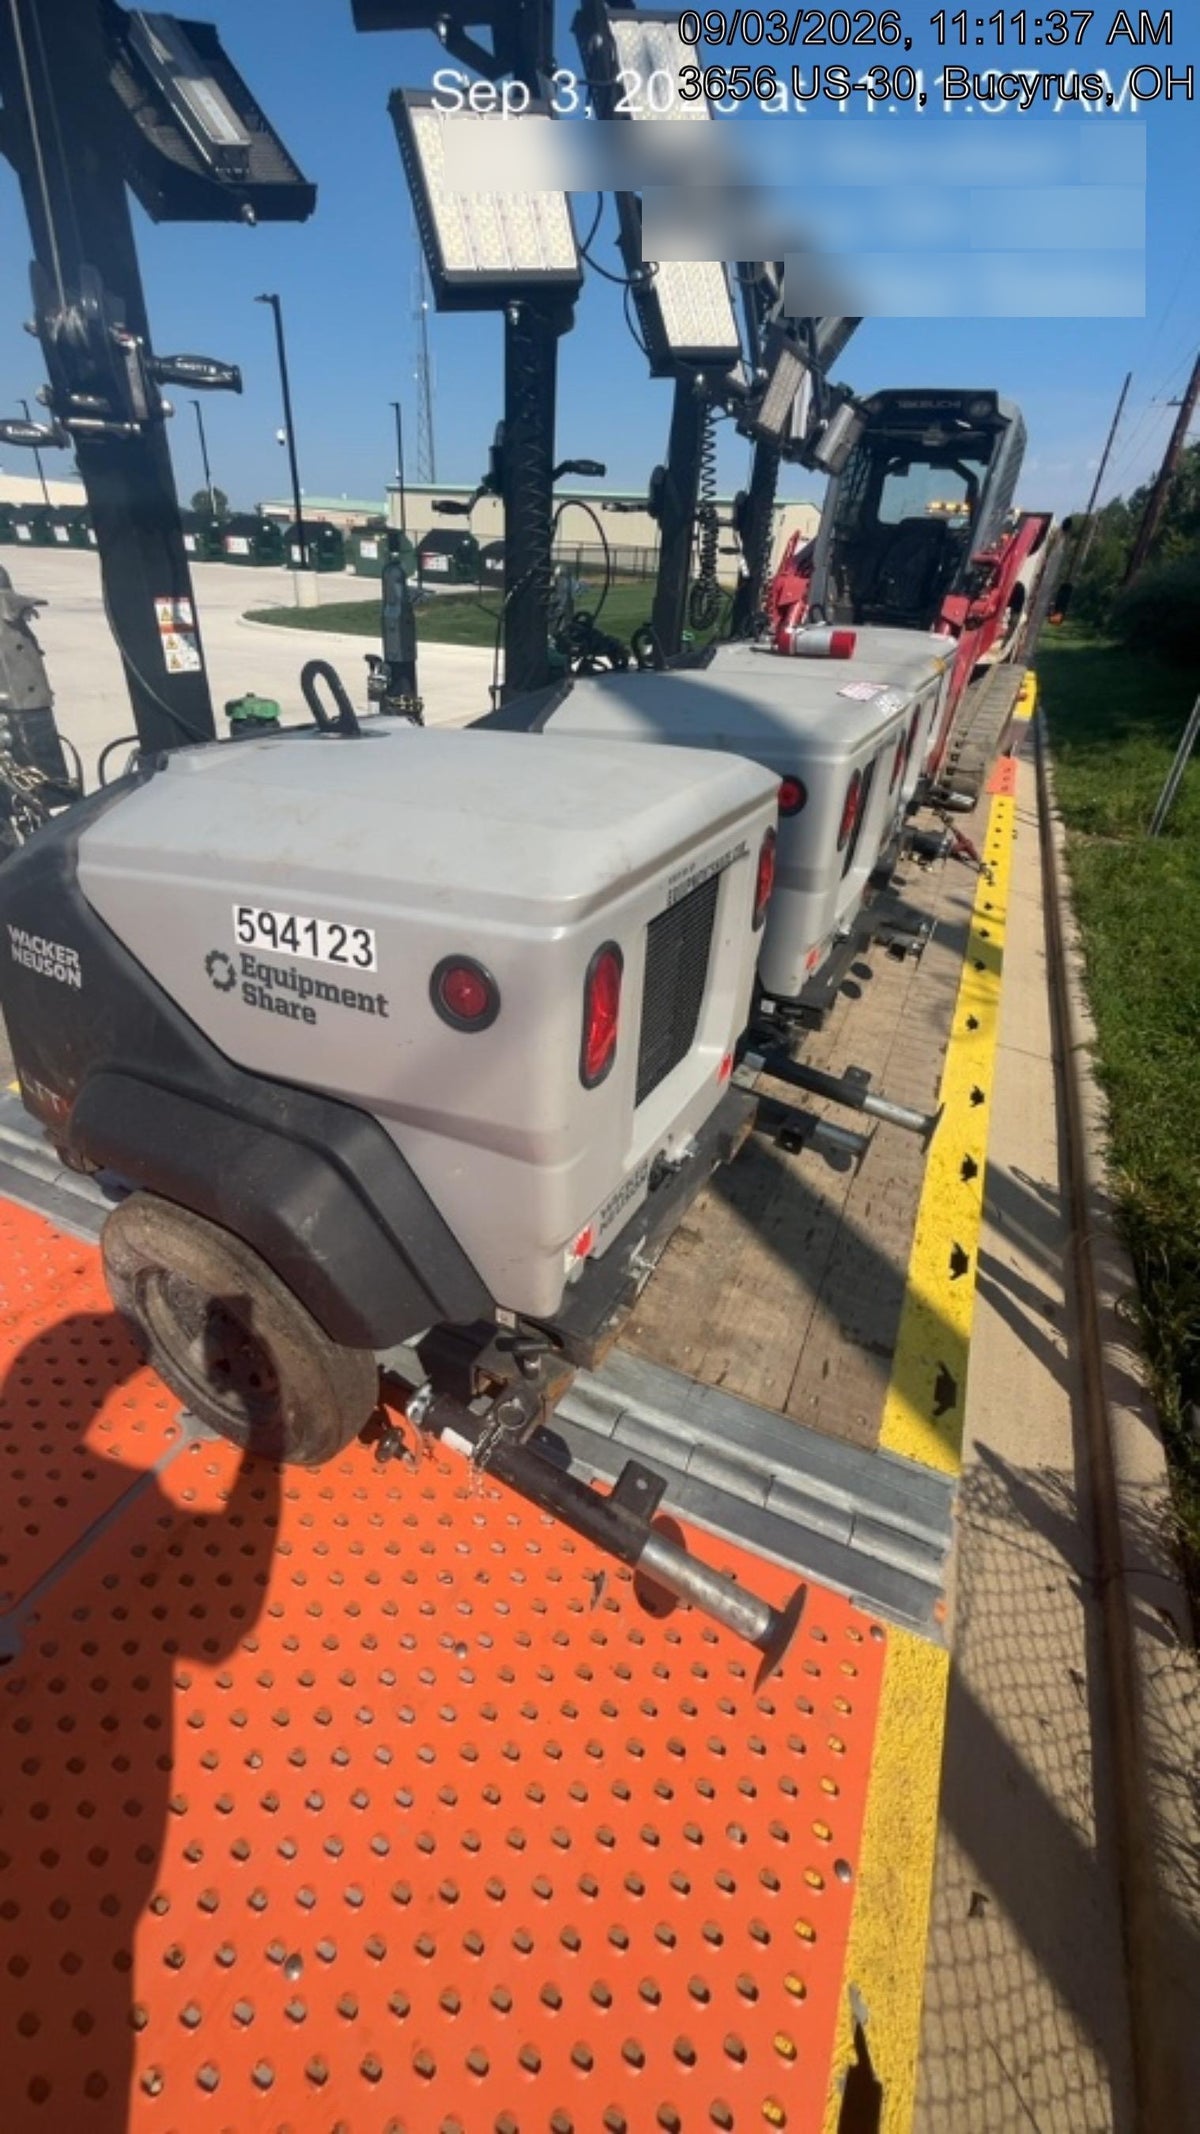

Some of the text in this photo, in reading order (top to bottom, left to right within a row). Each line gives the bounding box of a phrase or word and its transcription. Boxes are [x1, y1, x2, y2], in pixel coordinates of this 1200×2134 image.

[6, 924, 80, 969] WACKER
[238, 907, 373, 968] 594123
[11, 943, 82, 989] NEUSON
[240, 952, 390, 1018] Equipment
[242, 981, 317, 1025] Share
